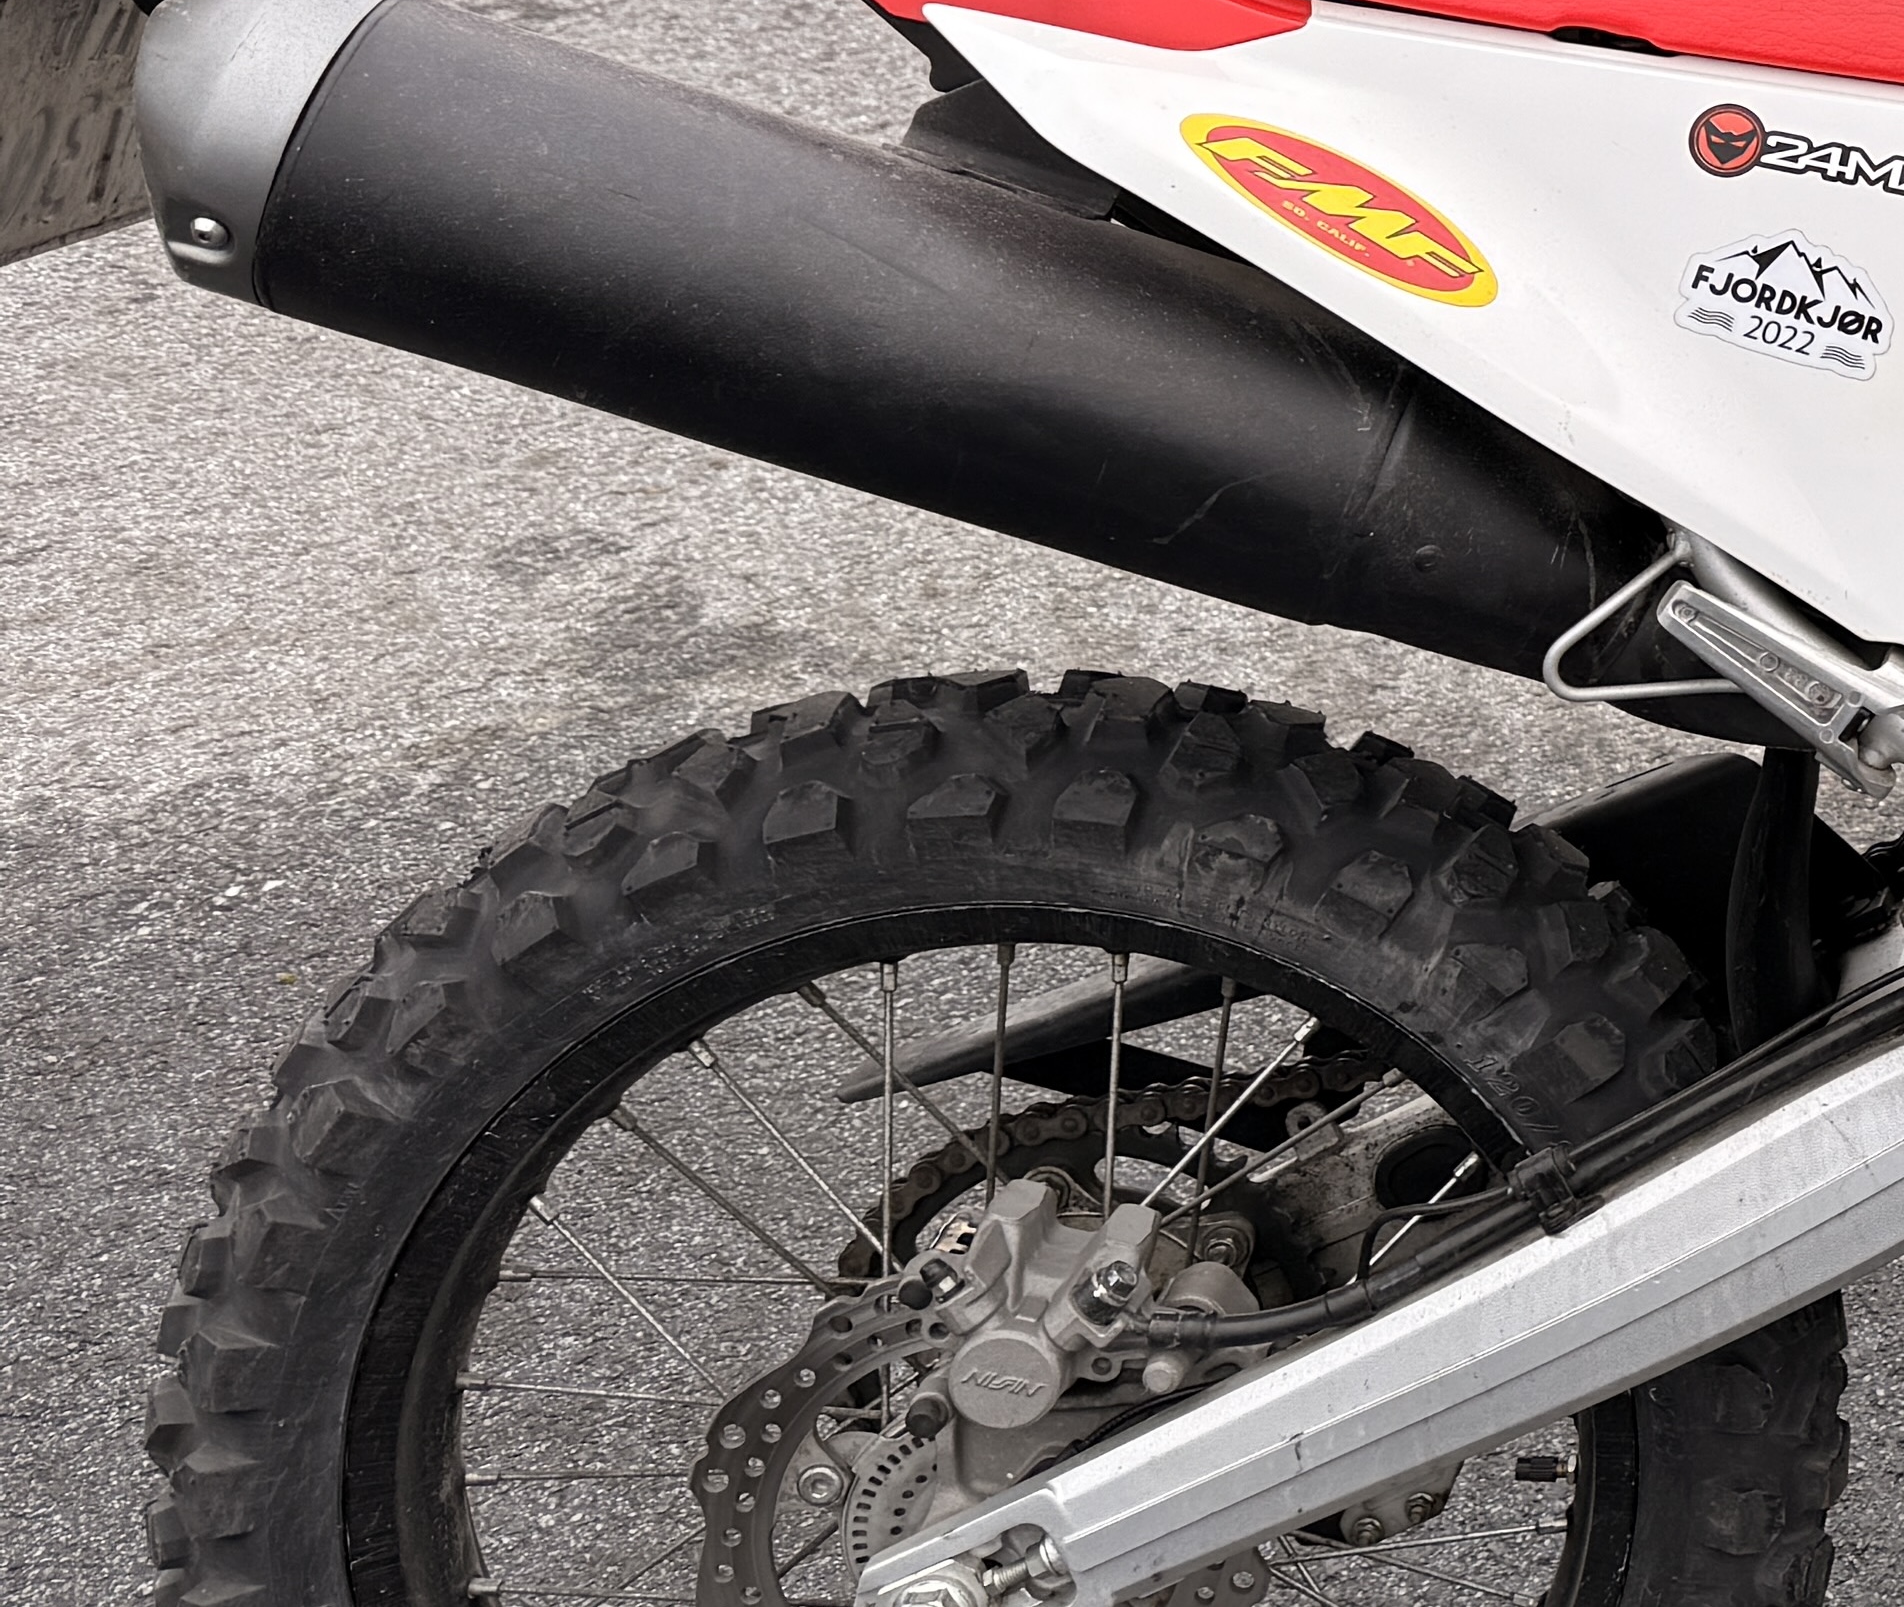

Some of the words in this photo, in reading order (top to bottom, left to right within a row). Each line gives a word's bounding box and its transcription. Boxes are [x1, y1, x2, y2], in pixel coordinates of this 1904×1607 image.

[1194, 136, 1485, 279] FMF
[1690, 263, 1884, 345] FJORDKJØR
[1743, 314, 1816, 357] 2022
